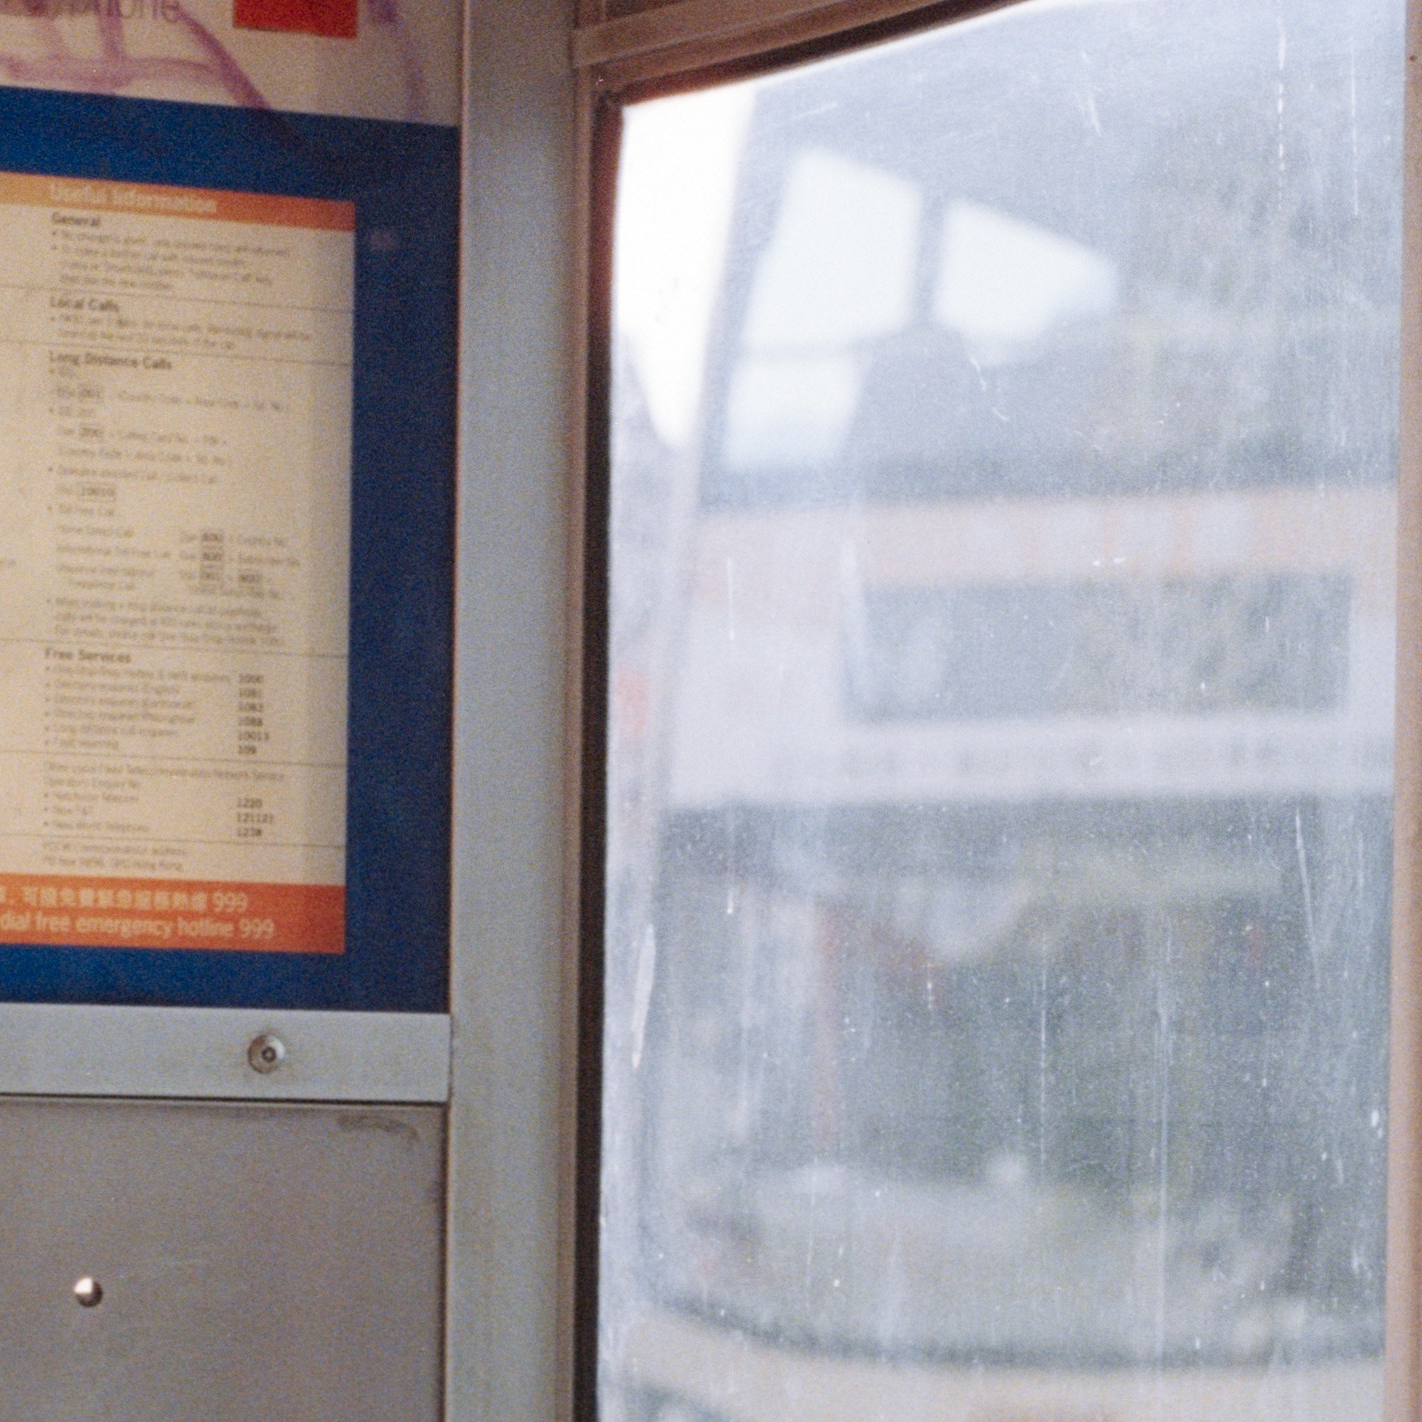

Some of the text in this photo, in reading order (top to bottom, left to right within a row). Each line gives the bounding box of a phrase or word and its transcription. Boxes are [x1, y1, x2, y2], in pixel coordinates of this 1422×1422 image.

[50, 183, 218, 214] Useful Information
[50, 296, 119, 312] Local Calls
[49, 351, 80, 367] Long
[143, 355, 174, 371] Calls
[45, 648, 74, 661] Free
[212, 891, 249, 914] 999
[36, 911, 71, 933] free
[77, 915, 173, 939] emergency
[178, 917, 234, 938] hotline
[238, 917, 276, 940] 999
